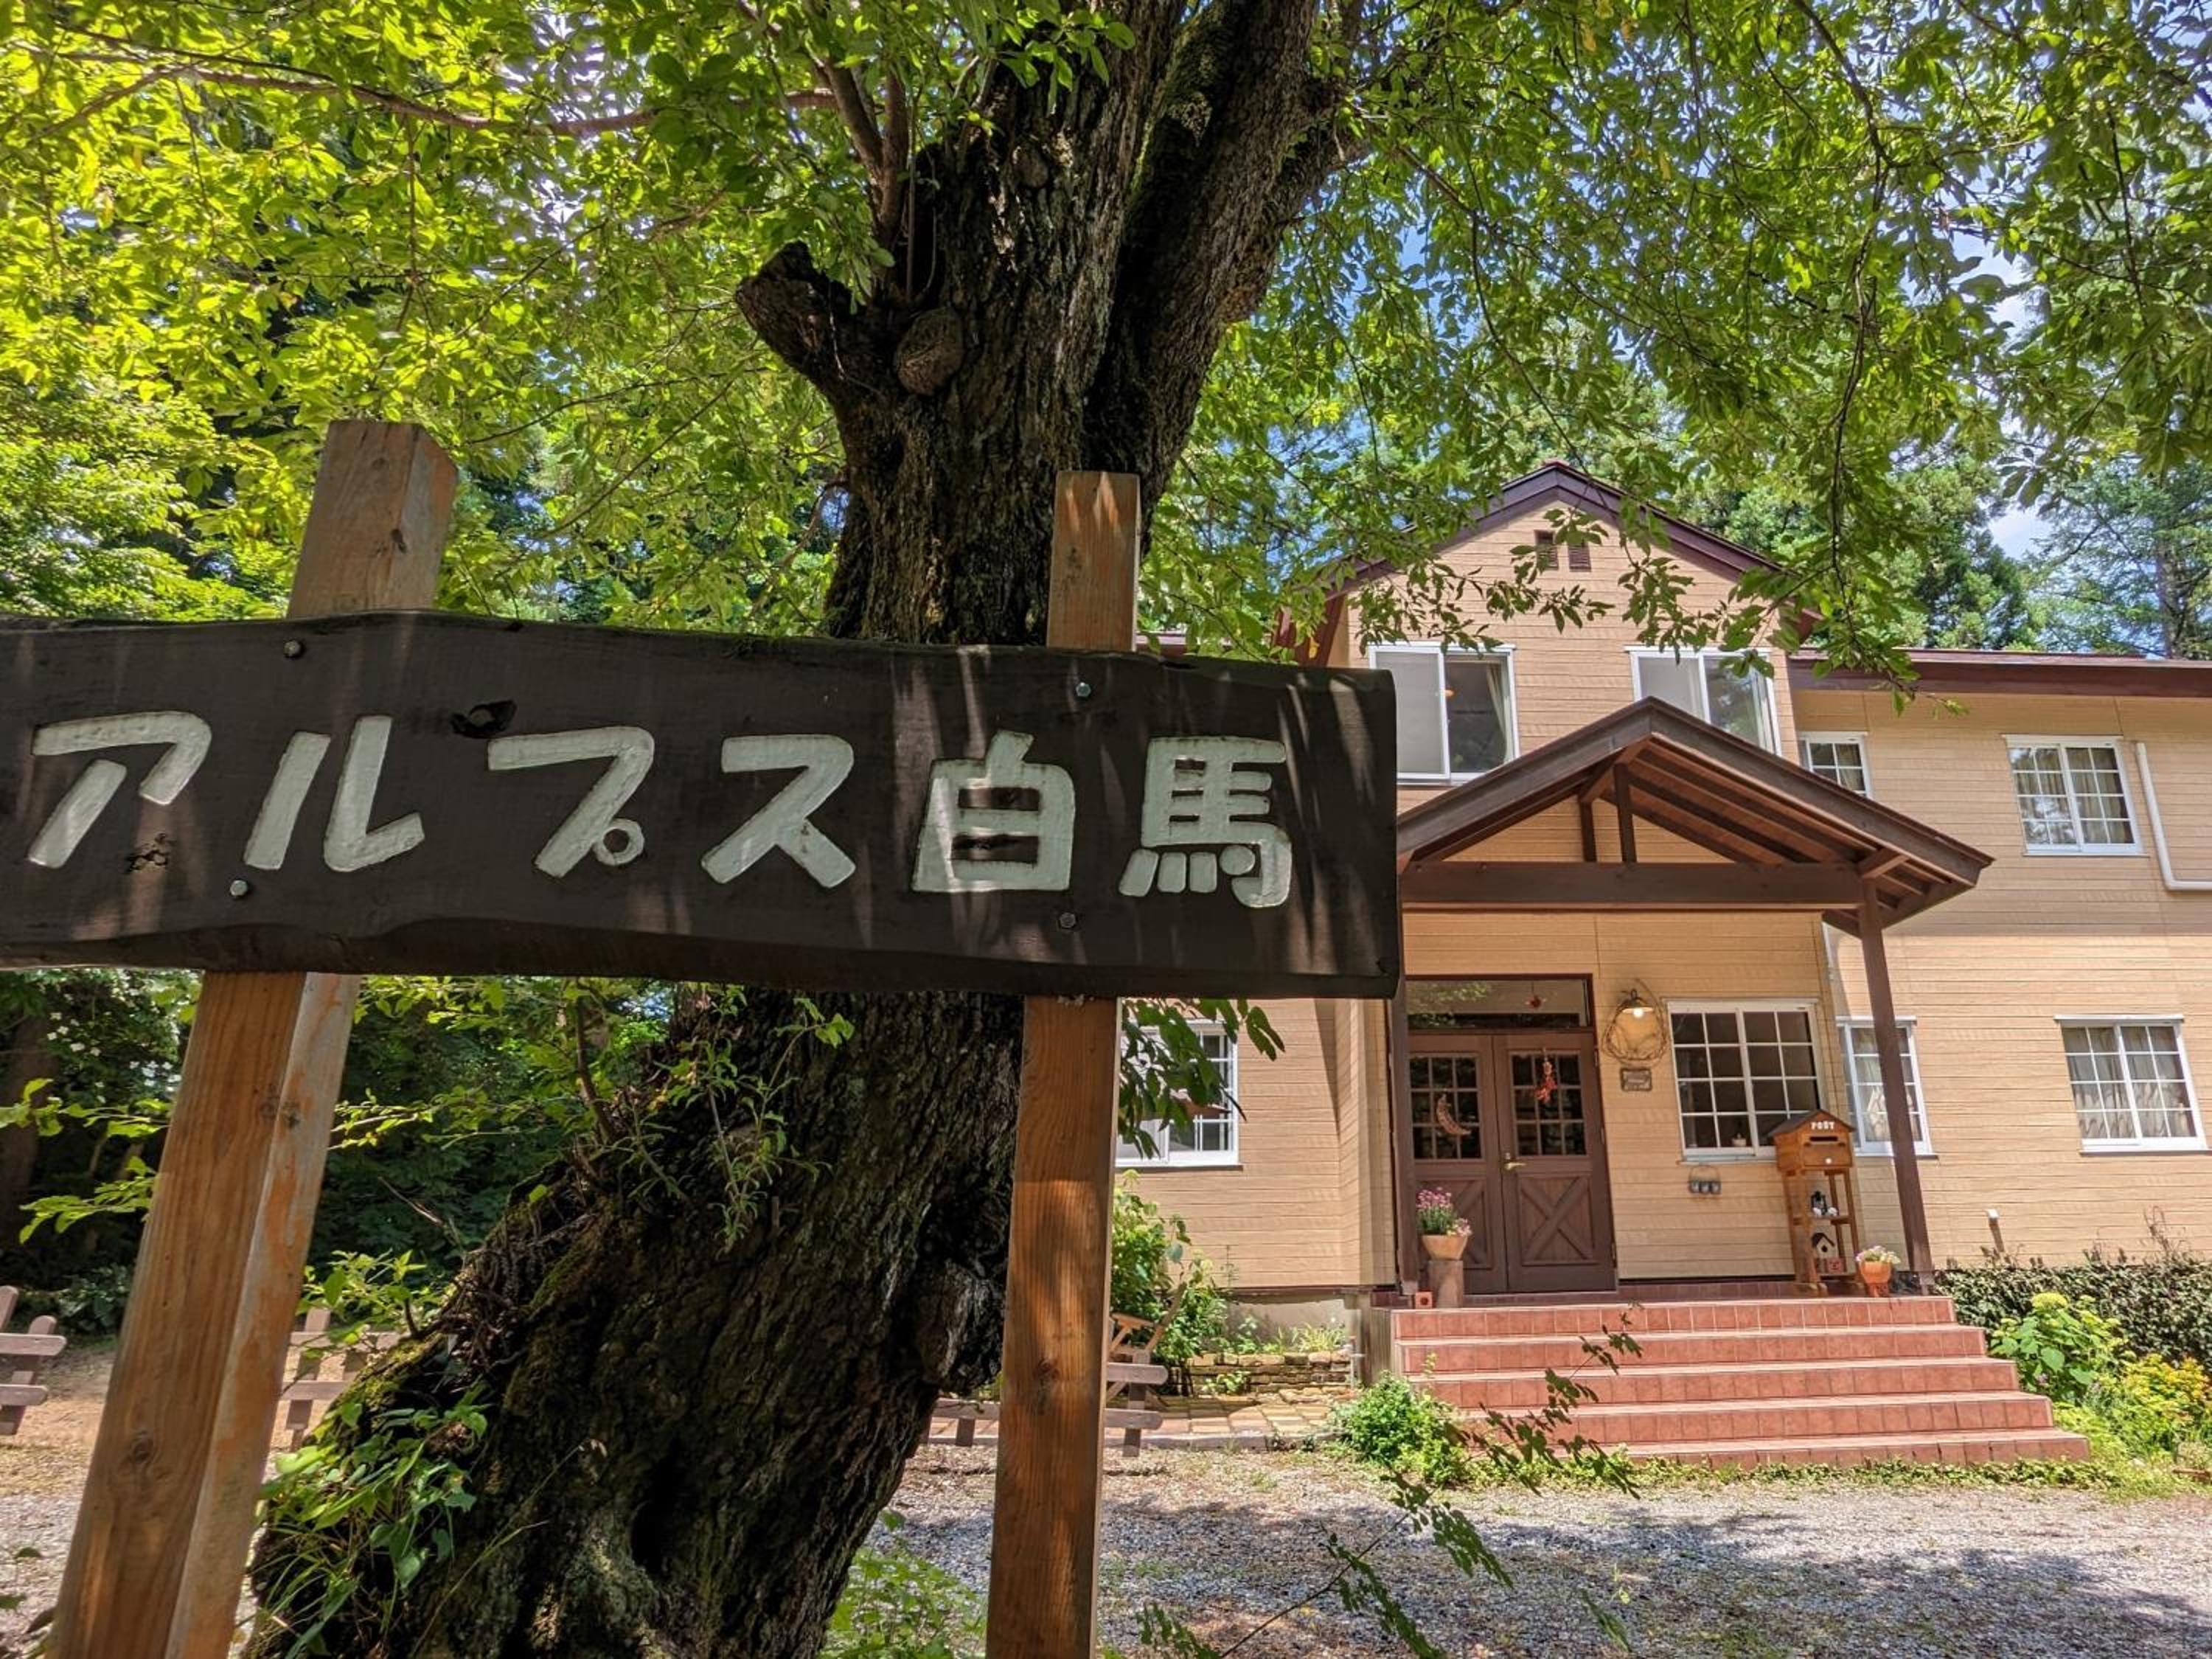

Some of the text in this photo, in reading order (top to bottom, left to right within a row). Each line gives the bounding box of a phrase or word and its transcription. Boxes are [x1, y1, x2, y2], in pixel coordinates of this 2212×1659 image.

[28, 710, 1292, 908] アルプス白馬
[1811, 1121, 1834, 1130] POST
